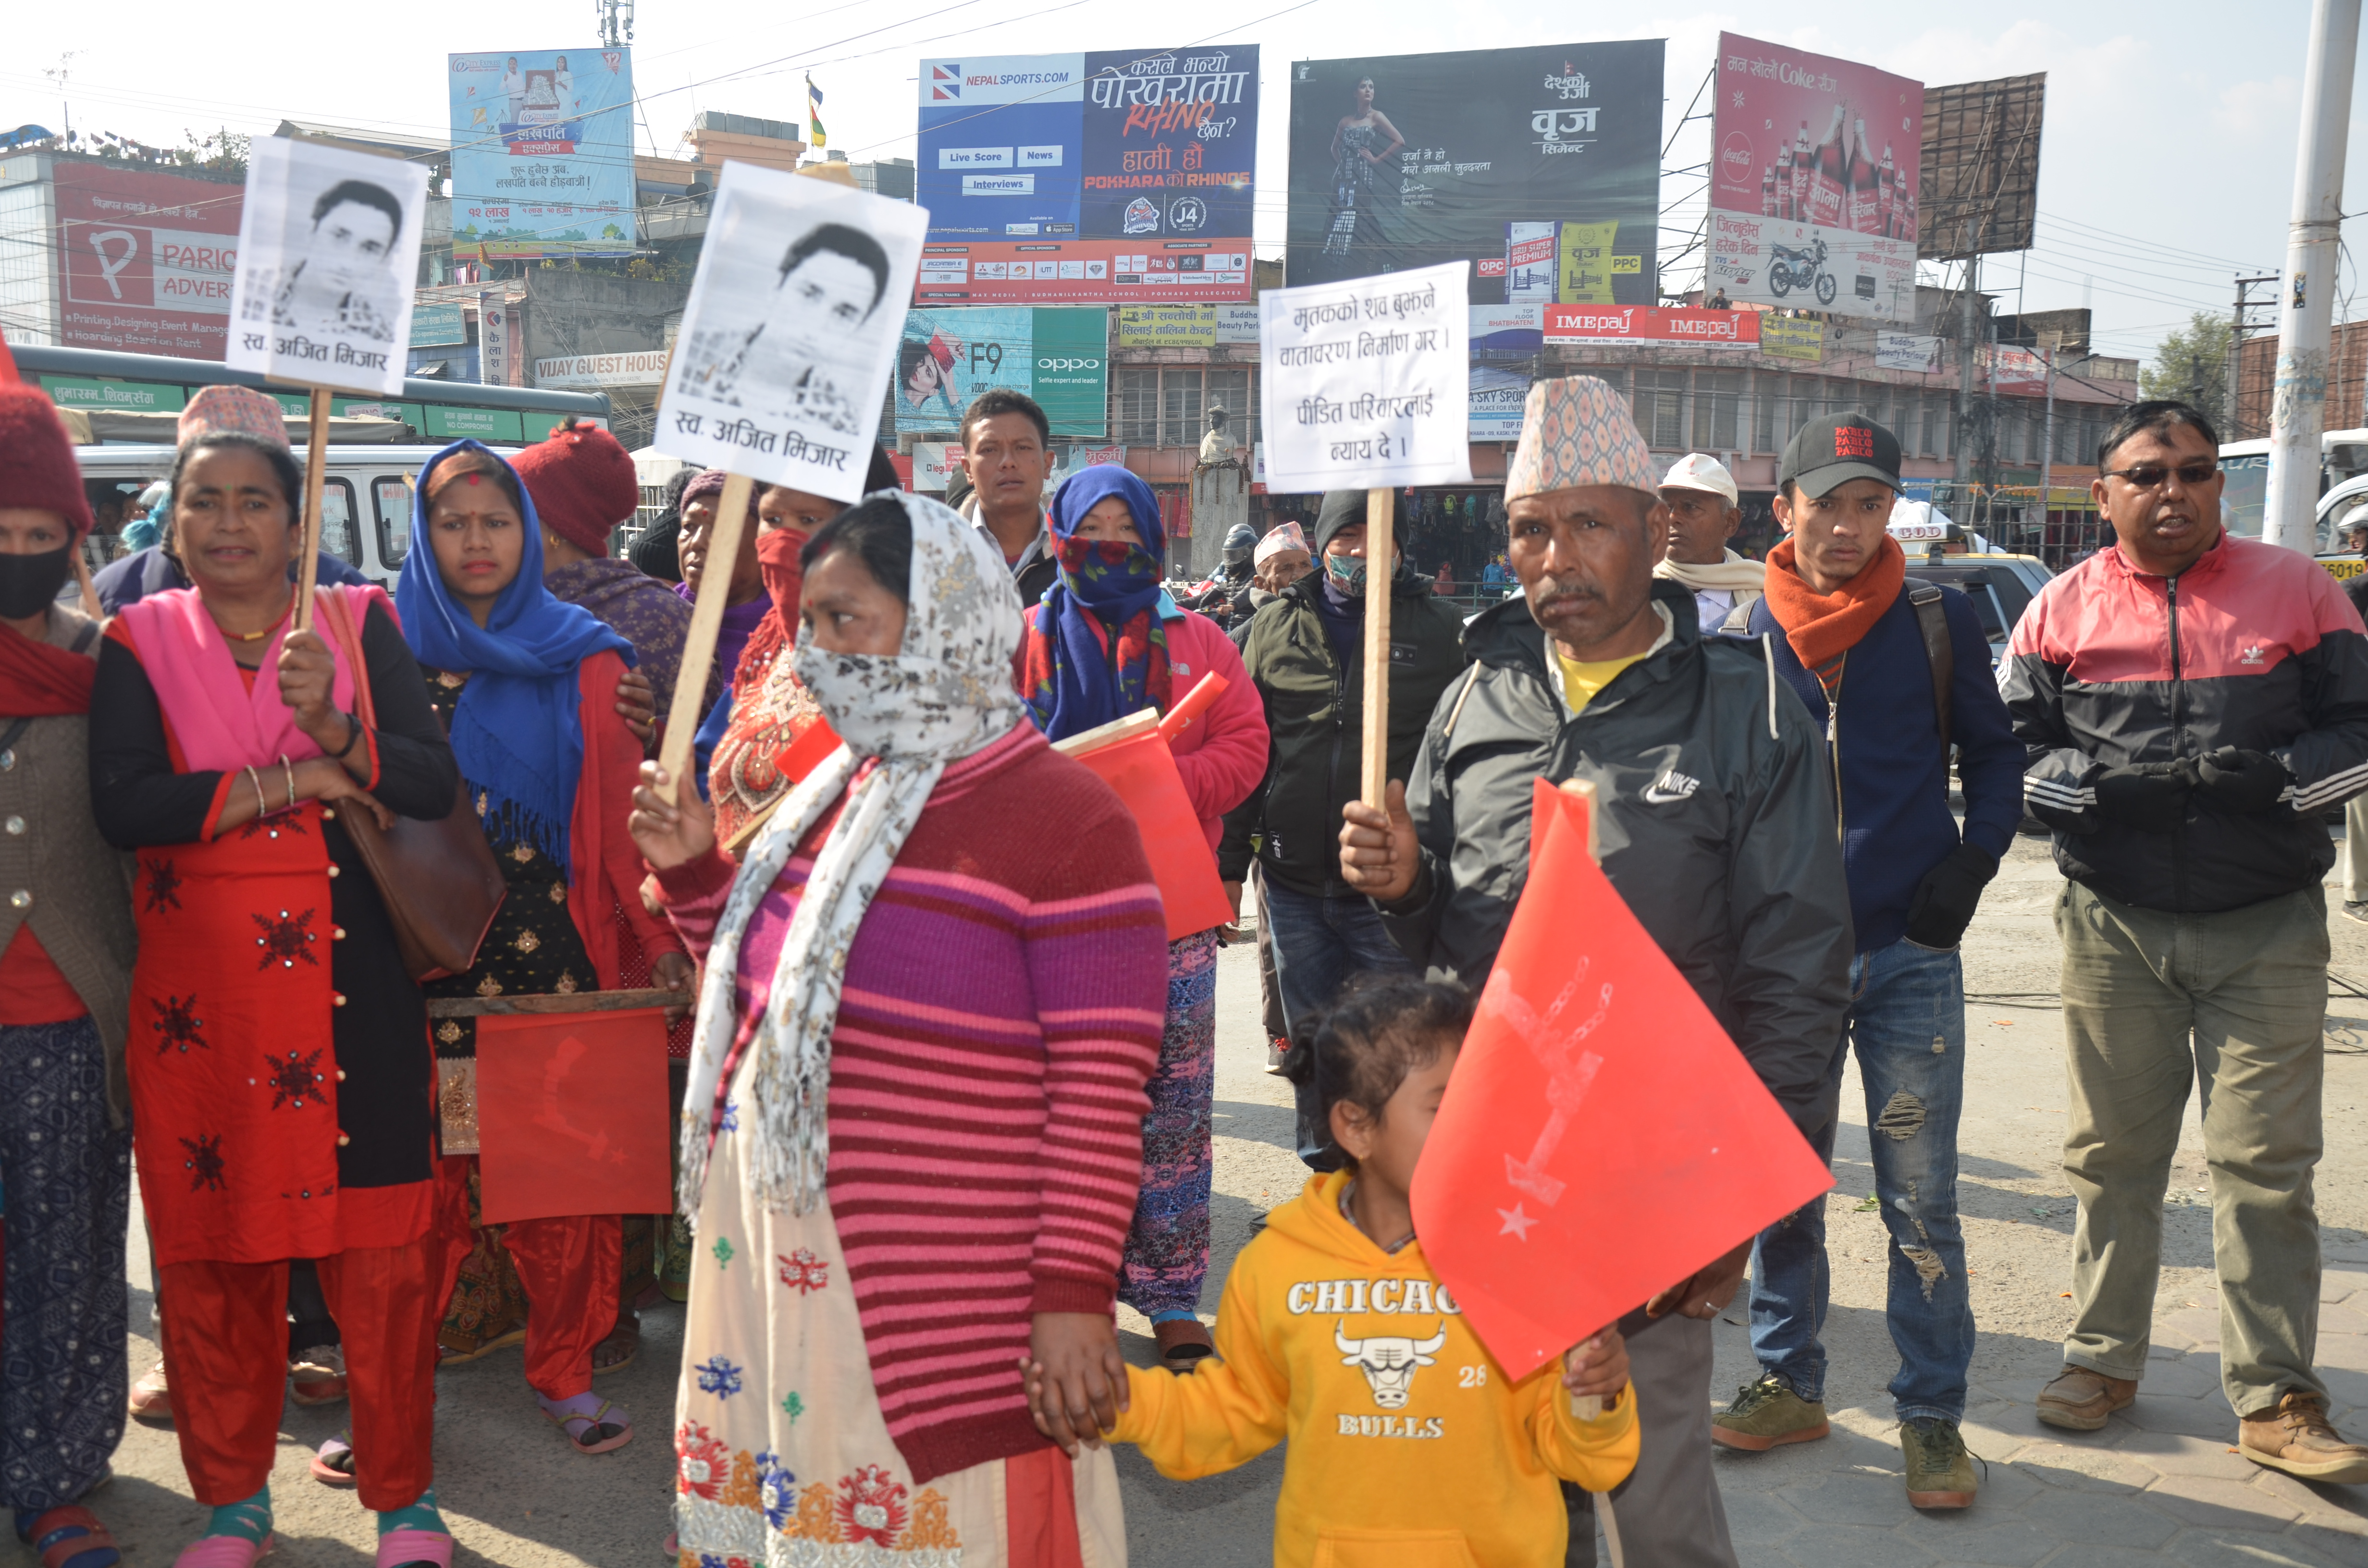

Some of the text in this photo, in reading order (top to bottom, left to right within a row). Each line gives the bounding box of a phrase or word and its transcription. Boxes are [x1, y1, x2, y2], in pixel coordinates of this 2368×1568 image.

[1131, 51, 1230, 75] कसले भन्यो
[966, 72, 1069, 86] NEPALSPORTS.COM
[1727, 55, 1748, 73] मन
[1779, 62, 1815, 89] Coke
[1091, 66, 1249, 109] पोखरामा
[1123, 96, 1215, 139] RHINO
[1531, 107, 1601, 141] वृज
[1027, 150, 1053, 161] News
[1435, 147, 1445, 160] हो
[1542, 143, 1584, 154] सिमेन्ट
[950, 152, 1002, 162] Live Score
[1123, 142, 1173, 172] हामी
[496, 176, 527, 188] लखपति
[974, 179, 1024, 189] Interviews
[1085, 170, 1250, 189] POKHARA को RHINOS
[1176, 207, 1197, 223] J4
[163, 244, 237, 272] PARIC
[1512, 248, 1552, 265] PREMIUM
[1613, 257, 1638, 269] PPC
[1714, 256, 1727, 264] TVS
[1480, 261, 1504, 271] OPC
[1714, 265, 1756, 278] Stryker
[163, 277, 234, 299] ADVER
[1141, 310, 1154, 320] श्री
[1158, 310, 1197, 321] सन्तोषी
[1230, 311, 1258, 319] Buddha
[192, 323, 229, 338] Manage
[440, 328, 454, 337] Society
[1122, 324, 1152, 336] सिलाई
[1155, 324, 1187, 335] तालिम
[1217, 321, 1242, 331] Beauty
[75, 329, 202, 349] Hoarding Board on Rent
[275, 338, 330, 364] अजित
[335, 342, 390, 373] मिजार
[971, 343, 1003, 375] F9
[539, 354, 667, 378] VIJAY GUEST HOUS
[1037, 358, 1099, 372] oppo
[971, 383, 988, 393] VOOC
[1012, 383, 1029, 392] charge
[1477, 391, 1497, 403] SKY
[456, 422, 494, 430] COMPROMISE
[1835, 426, 1872, 438] PABLO
[712, 417, 777, 454] अजित
[783, 428, 851, 473] मिजार
[1835, 436, 1873, 448] PABLO
[1836, 445, 1874, 458] PABLO
[1899, 526, 1941, 539] GOD
[2321, 564, 2364, 578] 6019
[1658, 770, 1701, 795] NIKE
[1286, 1278, 1464, 1315] CHICAG
[1336, 1413, 1444, 1439] BULLS
